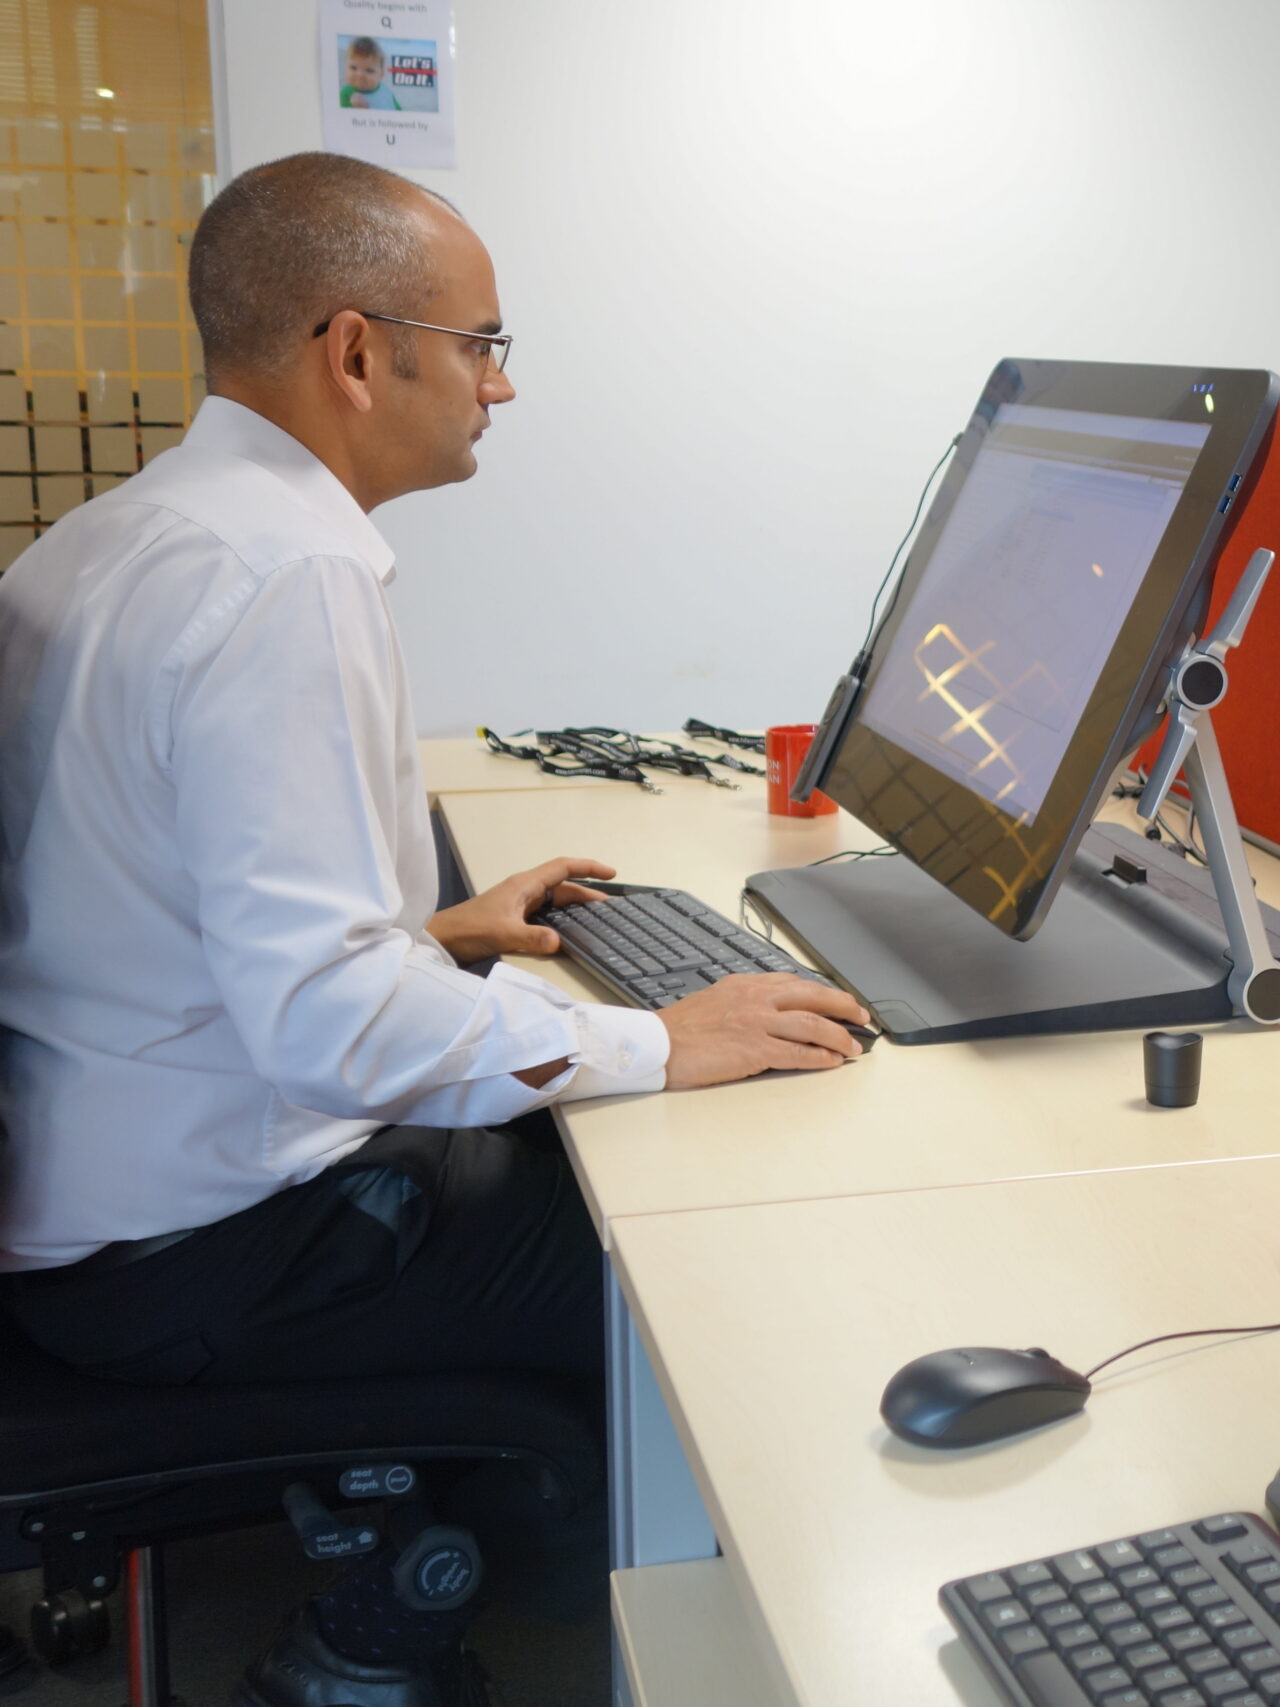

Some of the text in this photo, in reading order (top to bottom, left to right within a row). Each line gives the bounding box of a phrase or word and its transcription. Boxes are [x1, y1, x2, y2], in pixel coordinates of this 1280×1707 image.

[408, 4, 428, 12] with
[381, 16, 393, 29] Q
[394, 56, 431, 69] Let's
[395, 73, 414, 85] Do
[352, 118, 367, 128] But
[377, 119, 416, 129] followed
[417, 120, 429, 132] by
[386, 134, 396, 145] U
[350, 1469, 373, 1478] seat
[349, 1480, 379, 1492] depth
[315, 1533, 339, 1542] seat
[317, 1542, 352, 1554] height
